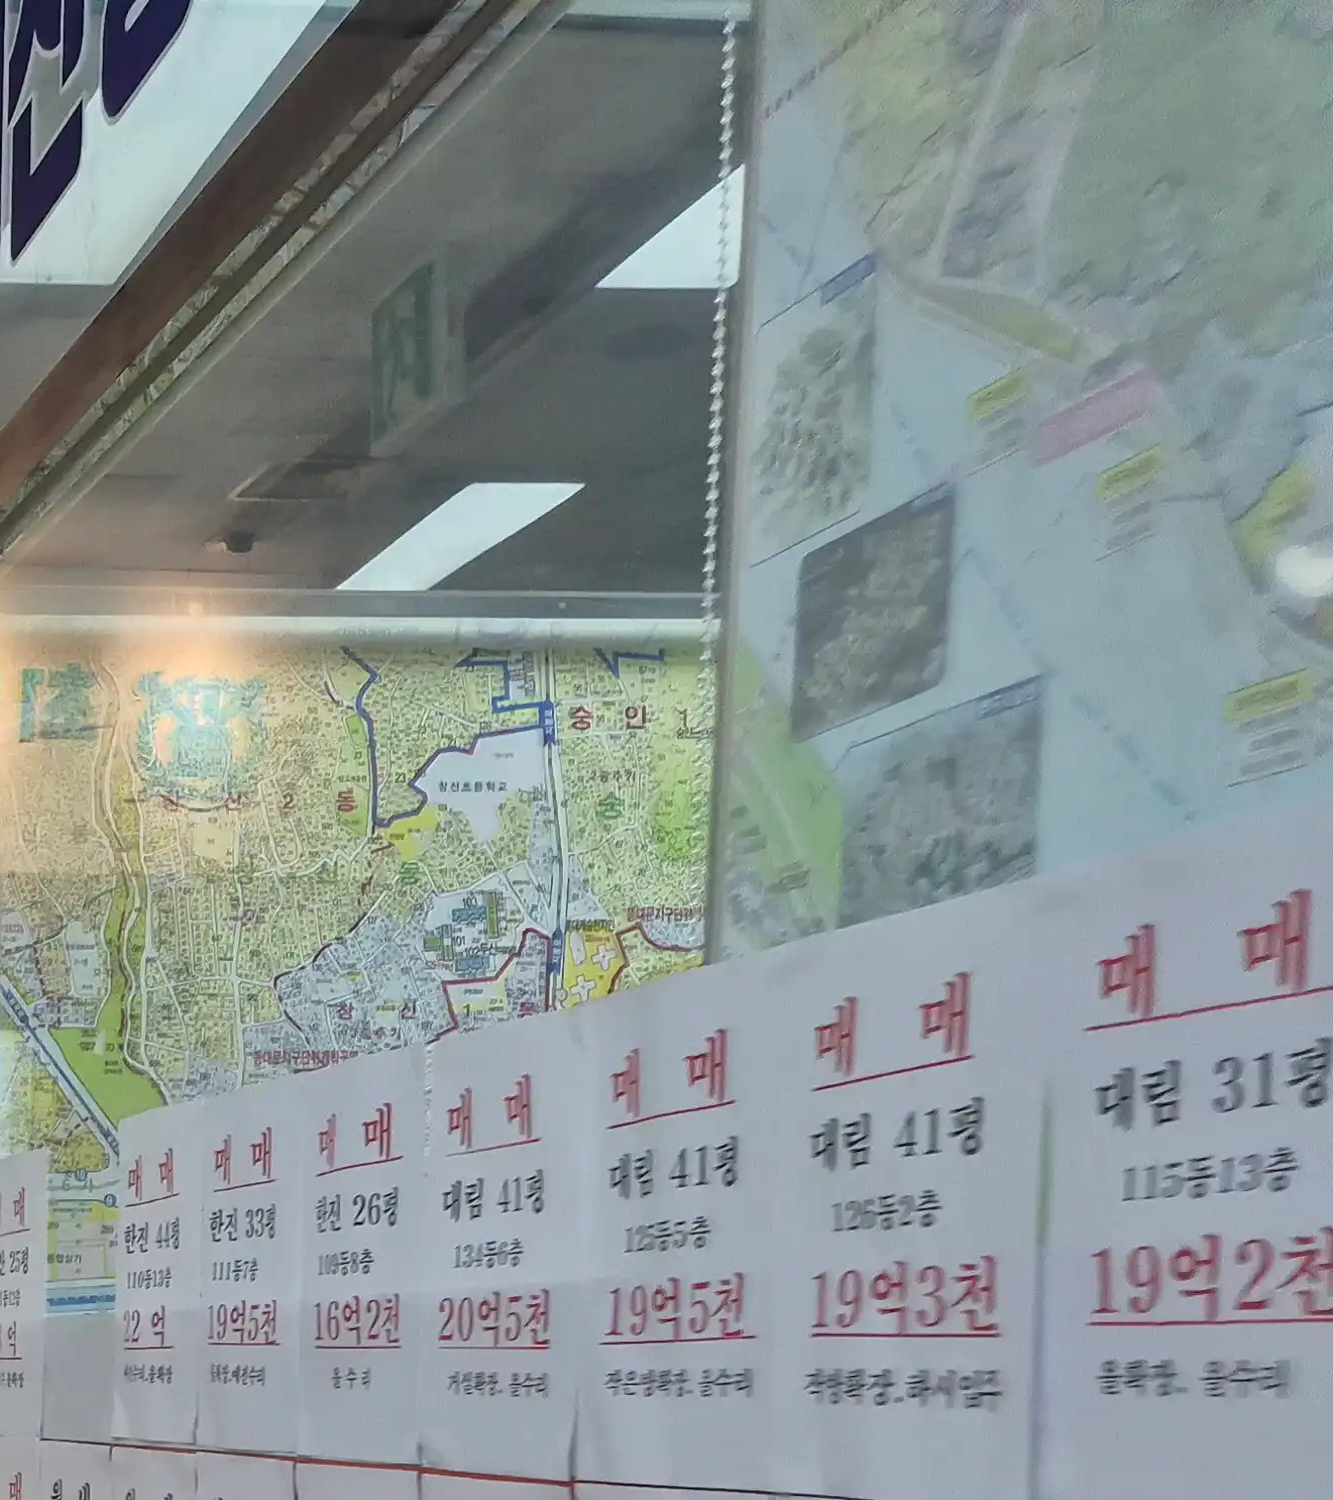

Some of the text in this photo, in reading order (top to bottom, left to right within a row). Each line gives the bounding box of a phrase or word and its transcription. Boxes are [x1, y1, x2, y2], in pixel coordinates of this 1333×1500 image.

[1092, 1036, 1333, 1132] 대림 31평
[809, 1096, 985, 1173] 대림 41평
[441, 1168, 546, 1223] 대림 41평
[607, 1136, 740, 1199] 대림 41평
[1120, 1146, 1301, 1202] 115동13층
[209, 1203, 277, 1243] 한진 33평
[352, 1186, 400, 1227] 26평
[124, 1218, 149, 1255] 한진
[810, 1254, 1001, 1335] 19억3천
[1089, 1225, 1333, 1321] 19억2천
[207, 1299, 277, 1344] 19억5천
[314, 1292, 401, 1346] 16억2천
[438, 1288, 551, 1346] 20억5천
[604, 1271, 746, 1343] 19억5천
